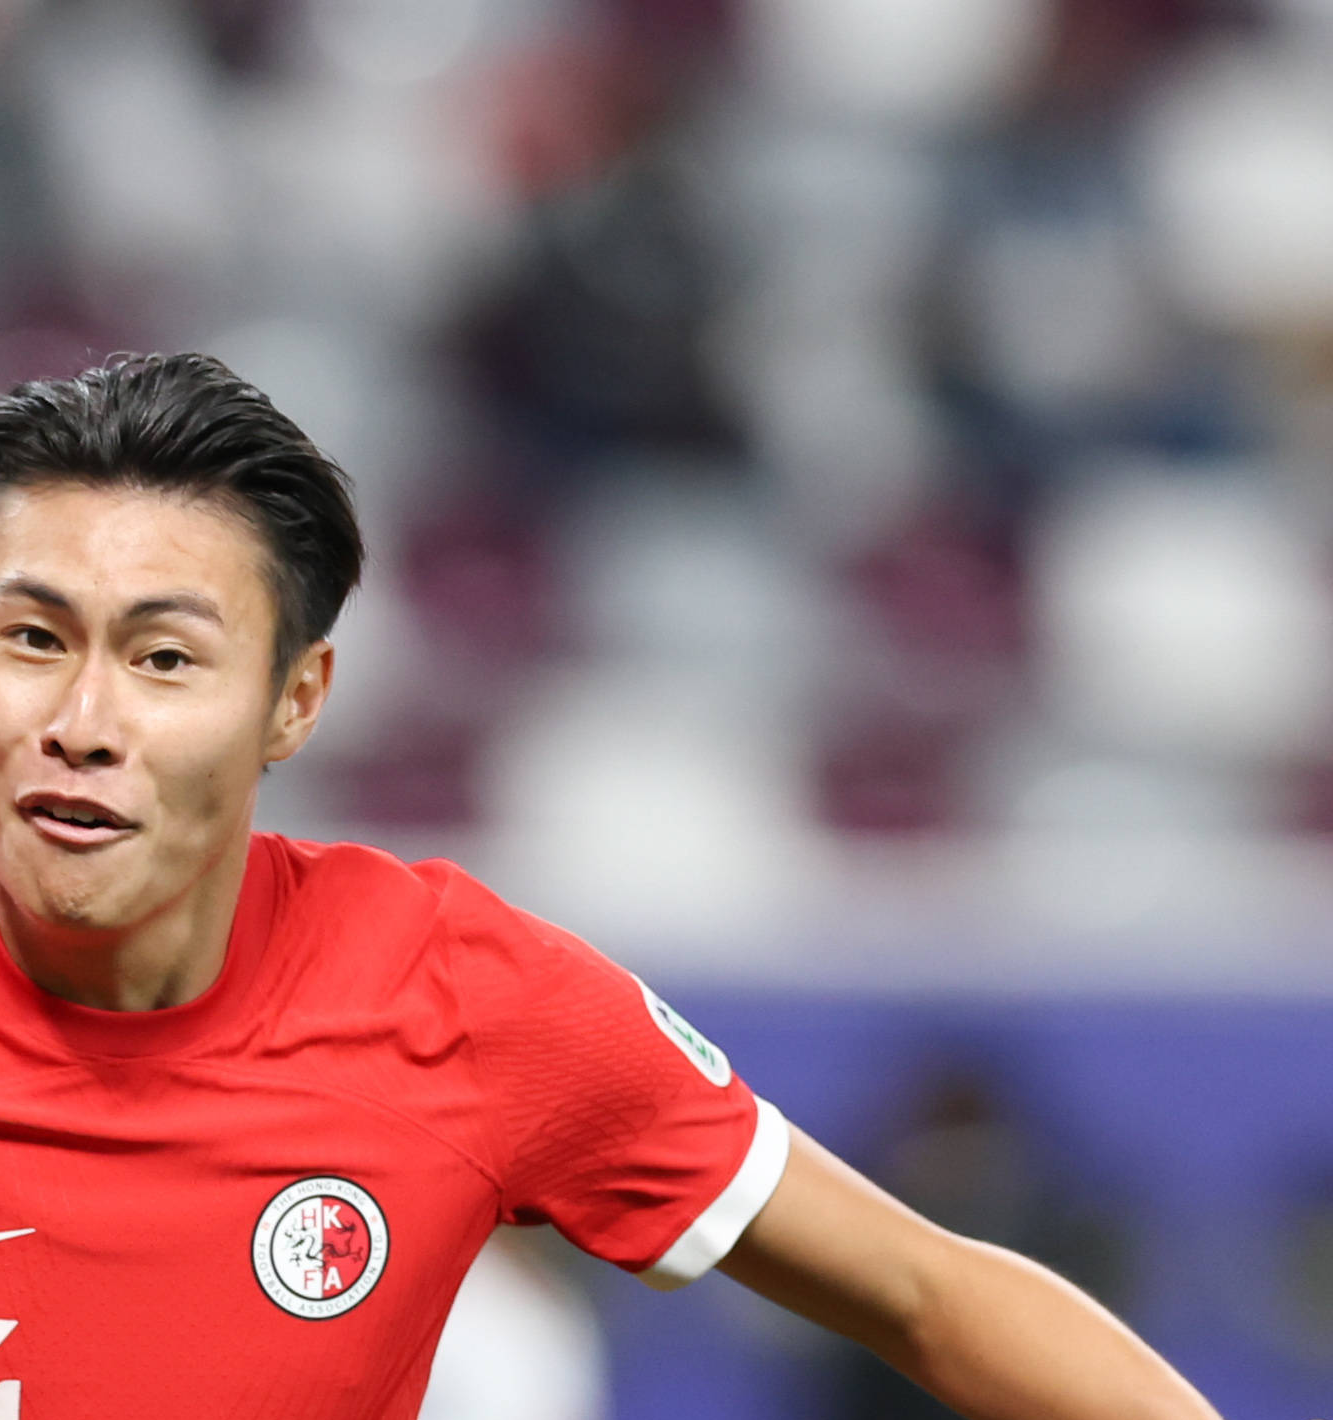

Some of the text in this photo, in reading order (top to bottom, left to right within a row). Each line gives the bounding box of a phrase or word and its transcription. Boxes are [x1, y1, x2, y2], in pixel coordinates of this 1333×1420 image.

[297, 1182, 332, 1194] HONG
[337, 1185, 367, 1206] KONG
[258, 1243, 293, 1308] FOOTBALL
[299, 1267, 378, 1314] ASSOCIATION
